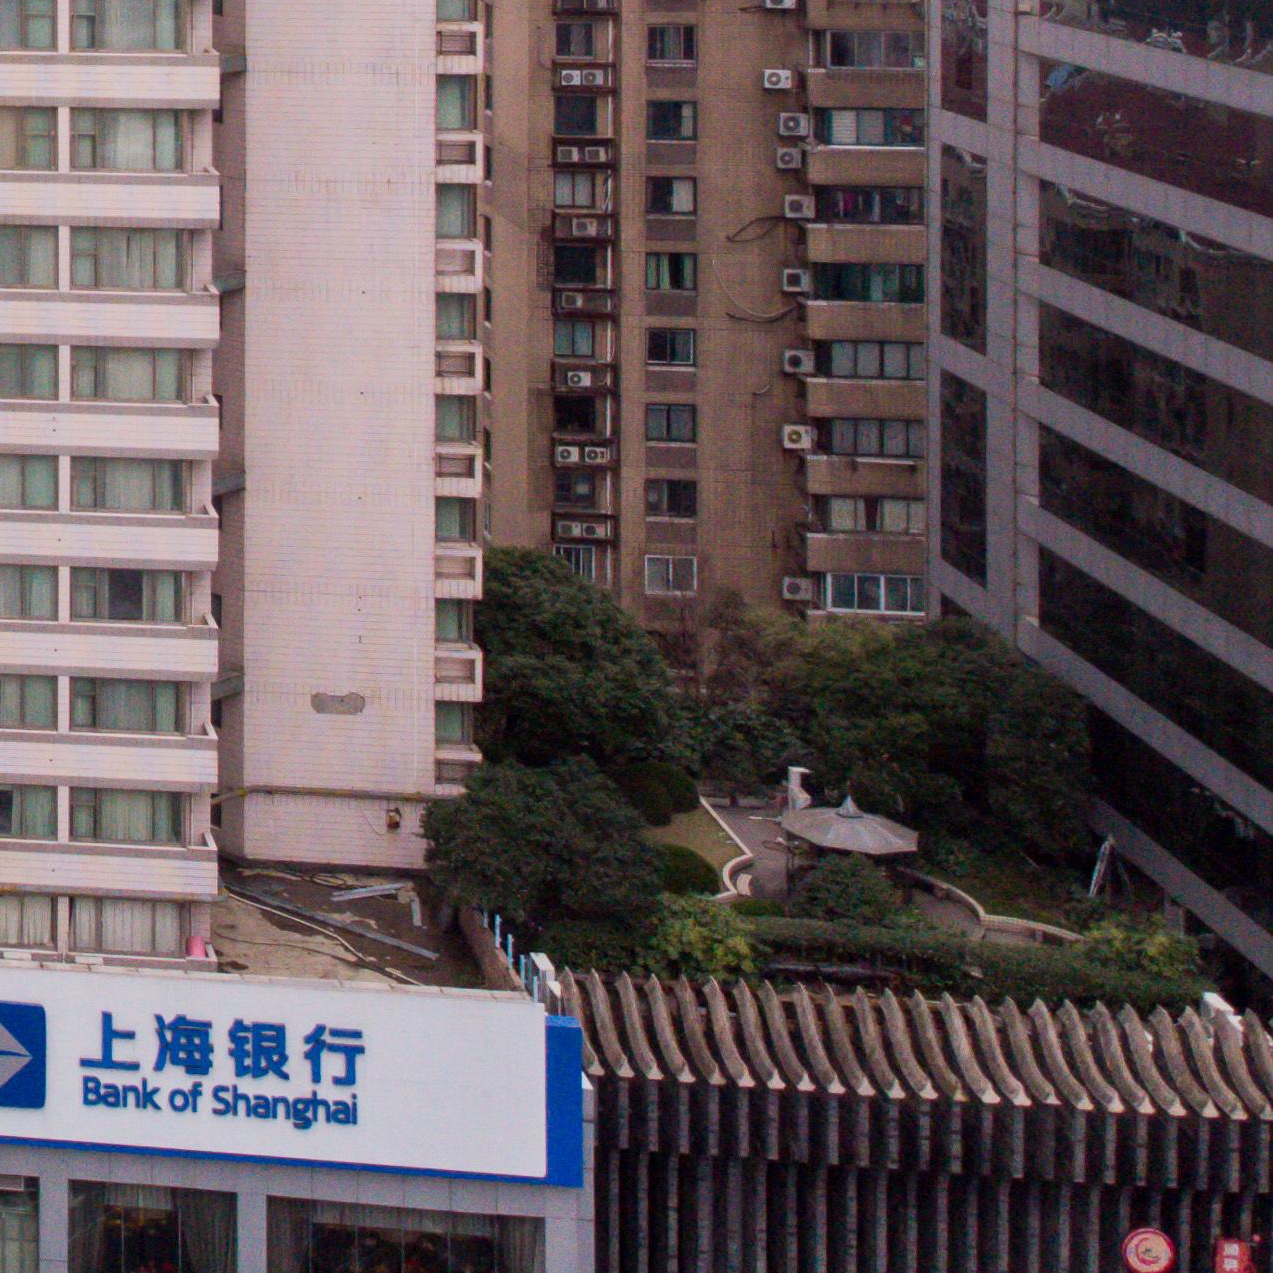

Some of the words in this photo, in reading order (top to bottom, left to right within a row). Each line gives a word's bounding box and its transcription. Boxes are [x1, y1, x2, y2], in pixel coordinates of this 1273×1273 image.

[79, 1010, 366, 1086] 上海银行
[82, 1076, 161, 1111] Bank
[169, 1081, 204, 1115] of
[212, 1085, 358, 1129] Shanghai
